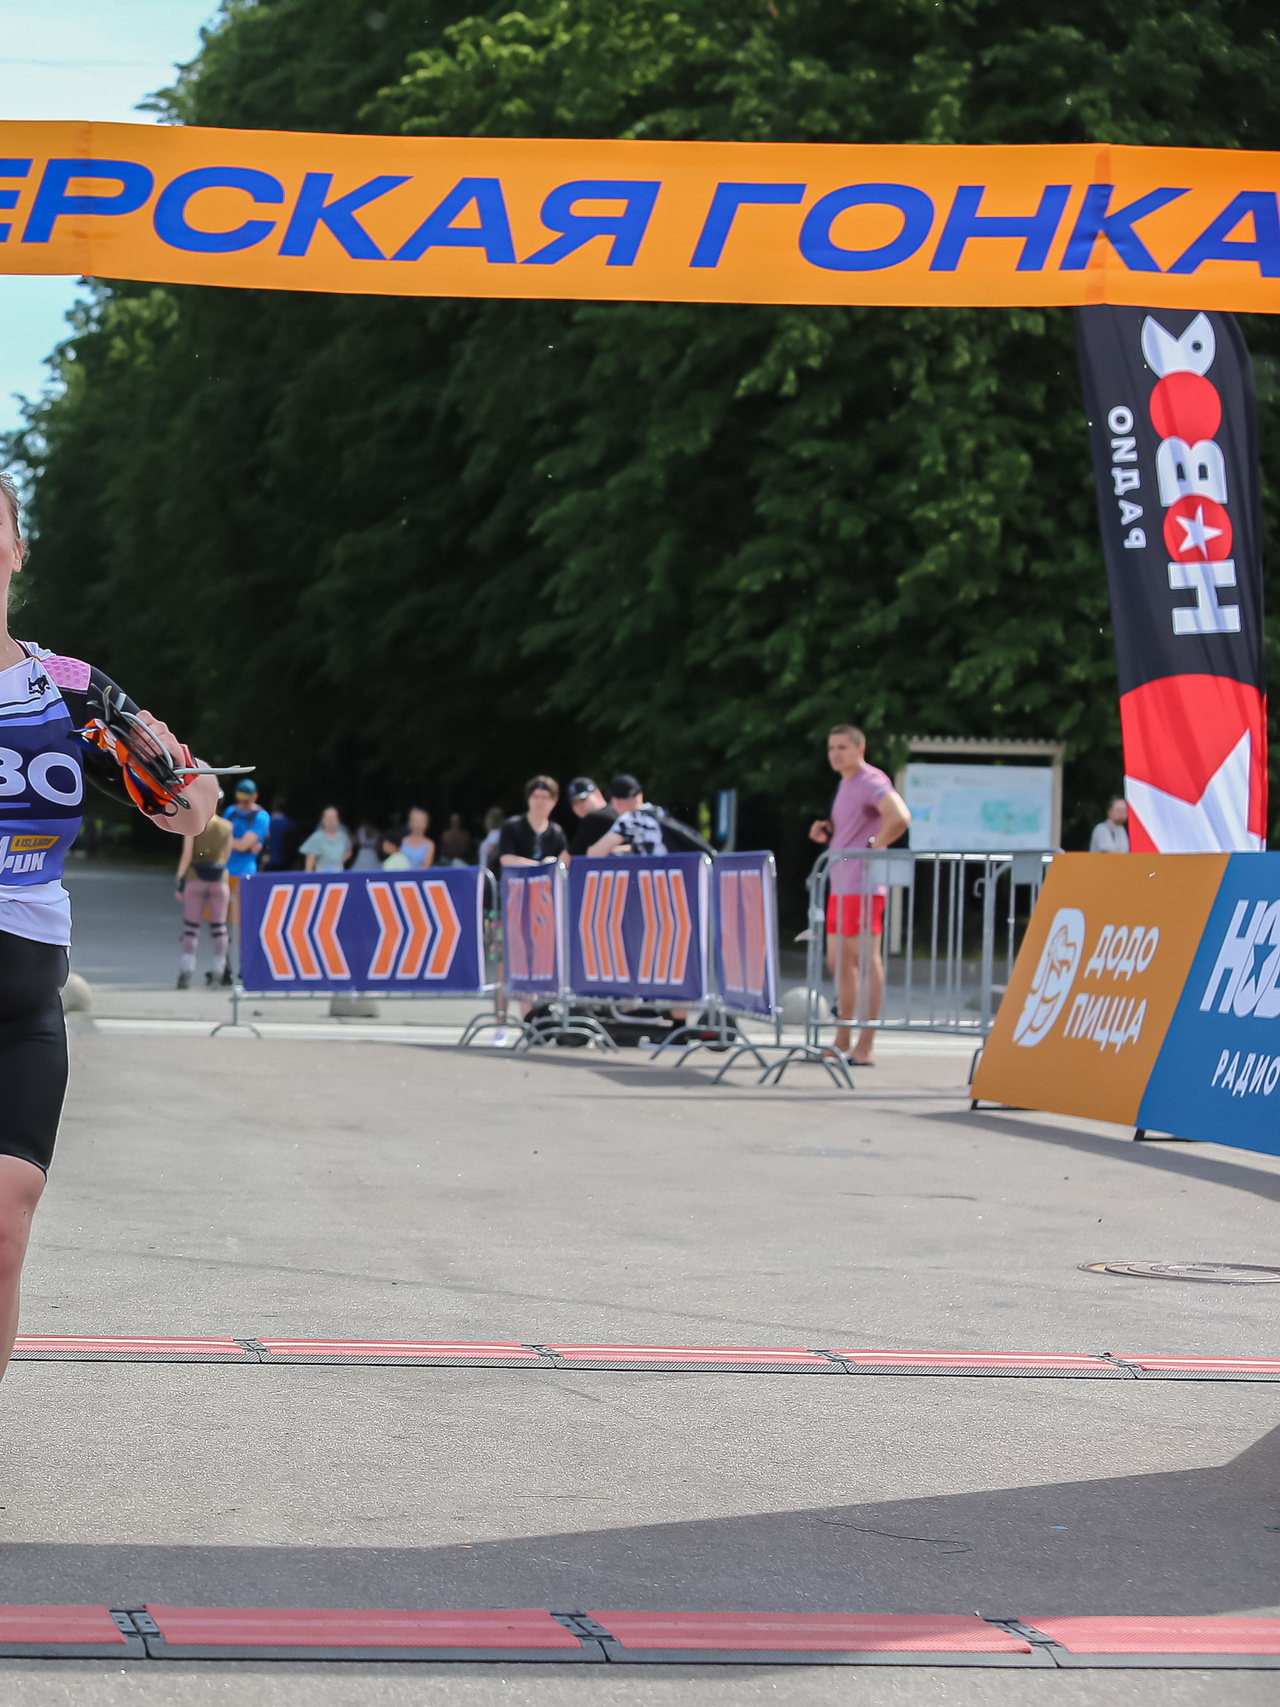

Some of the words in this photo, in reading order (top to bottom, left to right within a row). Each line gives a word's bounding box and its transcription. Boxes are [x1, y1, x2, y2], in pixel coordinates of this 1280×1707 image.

[688, 181, 1280, 278] ГОНКА
[1084, 924, 1161, 982] ДОДО
[1063, 993, 1148, 1054] ПИЦЦА
[1211, 1049, 1280, 1098] РАДИО
